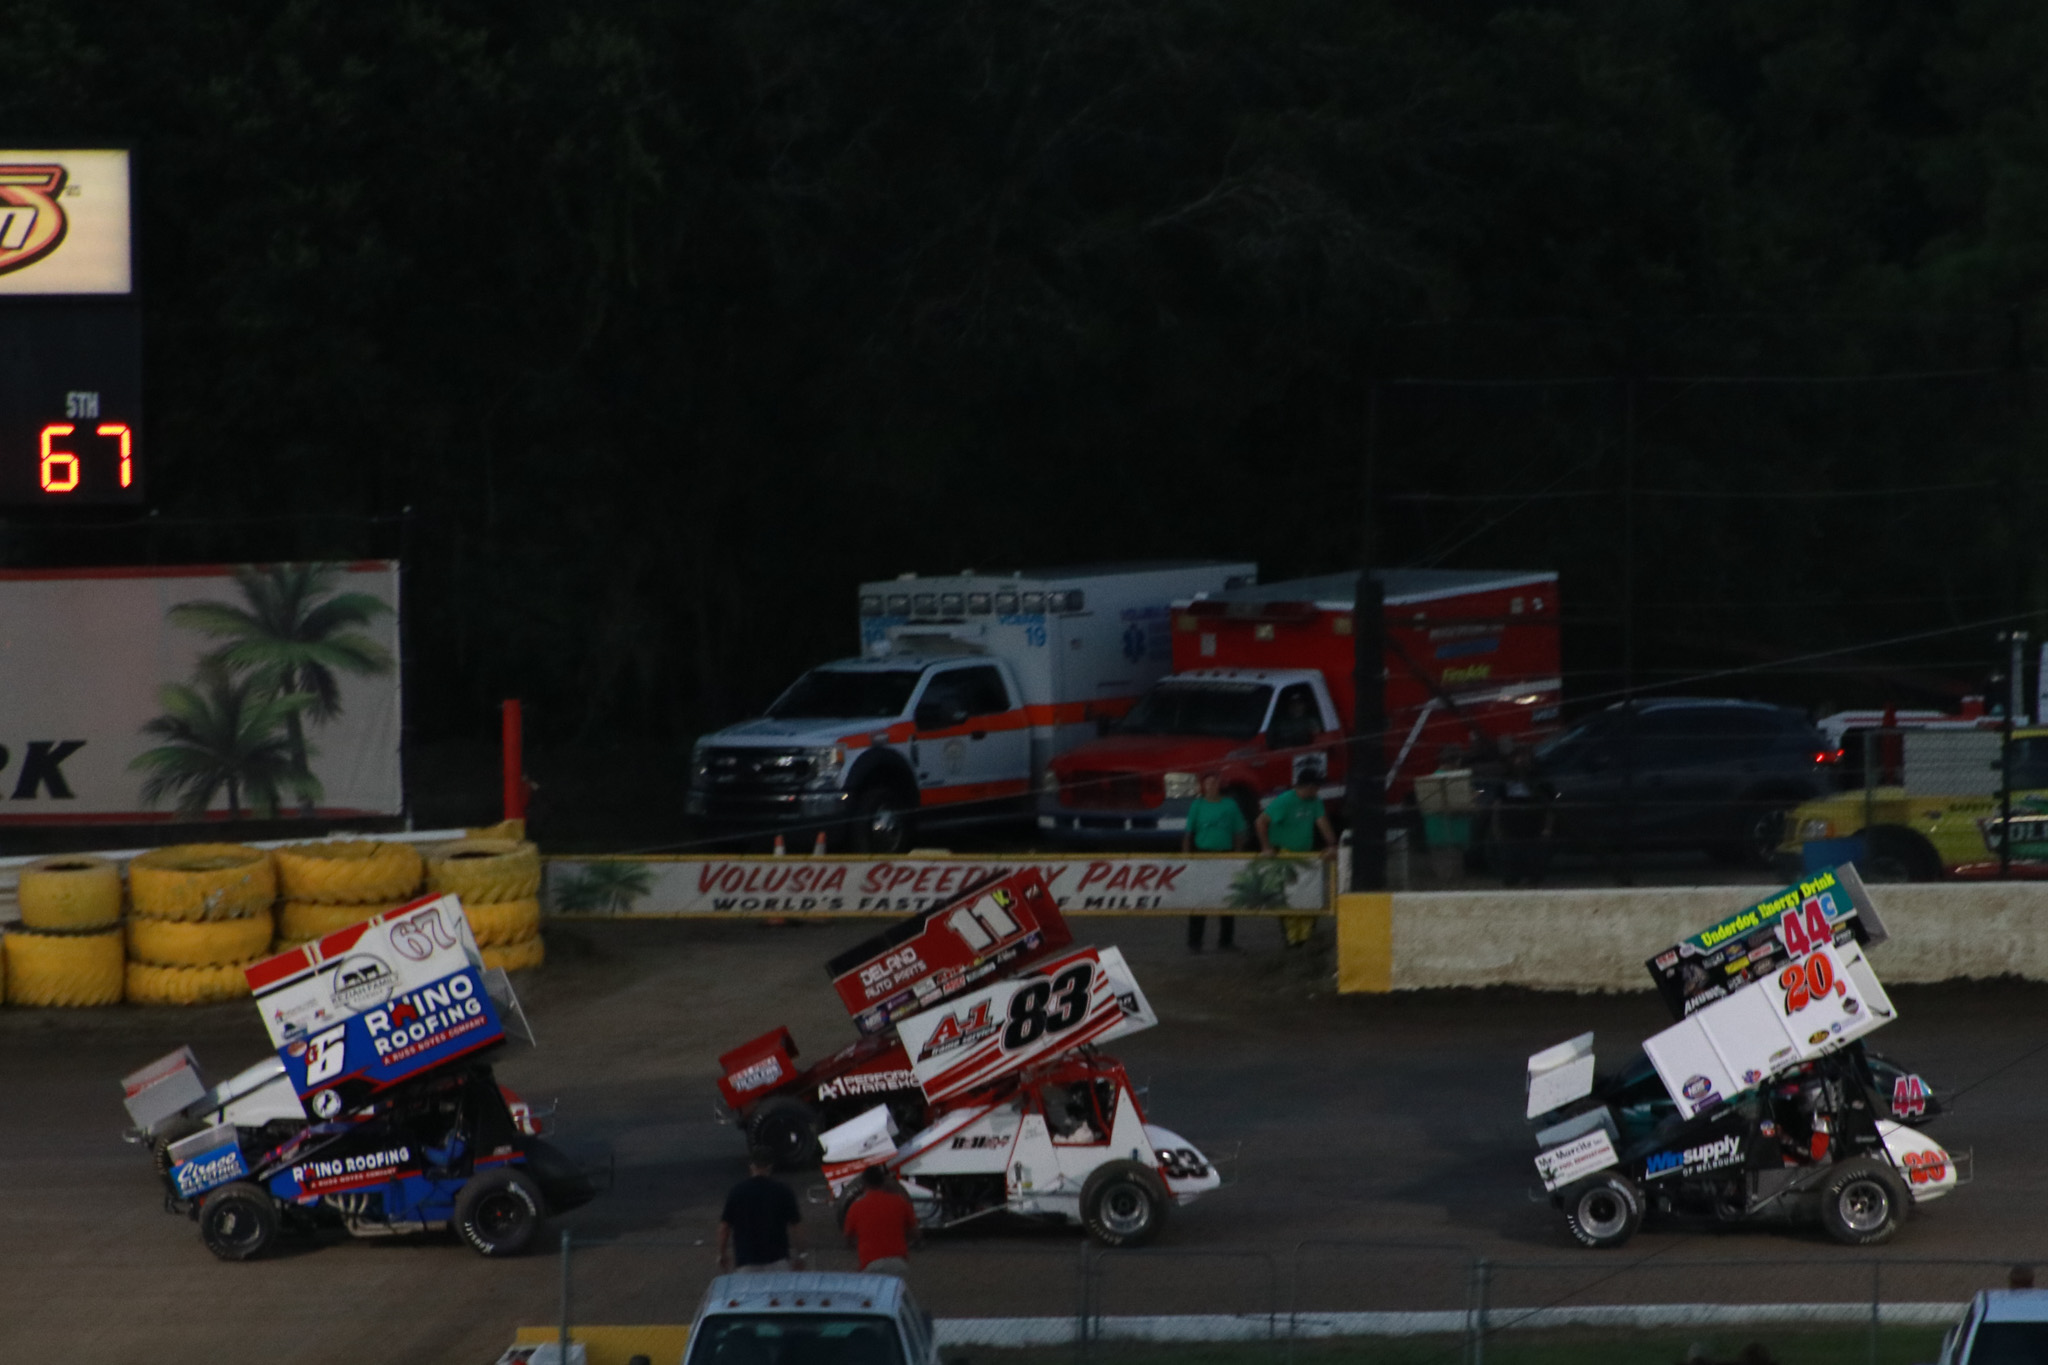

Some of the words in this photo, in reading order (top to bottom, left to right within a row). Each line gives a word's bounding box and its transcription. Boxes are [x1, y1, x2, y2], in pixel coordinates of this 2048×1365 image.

[66, 391, 99, 419] 5TH
[41, 423, 132, 492] 67
[0, 742, 87, 799] K
[698, 861, 848, 894] VOLUSIA
[860, 861, 1068, 894] SPEEDY
[1077, 860, 1187, 893] PARK
[713, 898, 843, 911] WORLD'S
[1701, 912, 1760, 947] Underdog
[1757, 890, 1801, 919] Energy
[1800, 872, 1836, 899] Drink
[390, 907, 457, 961] 67
[859, 945, 918, 987] DELAND
[1001, 960, 1097, 1051] 83
[374, 997, 482, 1057] ROOFING
[344, 1145, 411, 1173] ROOFING
[1645, 1133, 1741, 1175] Winsupply
[1695, 1151, 1746, 1174] MELBOURNE
